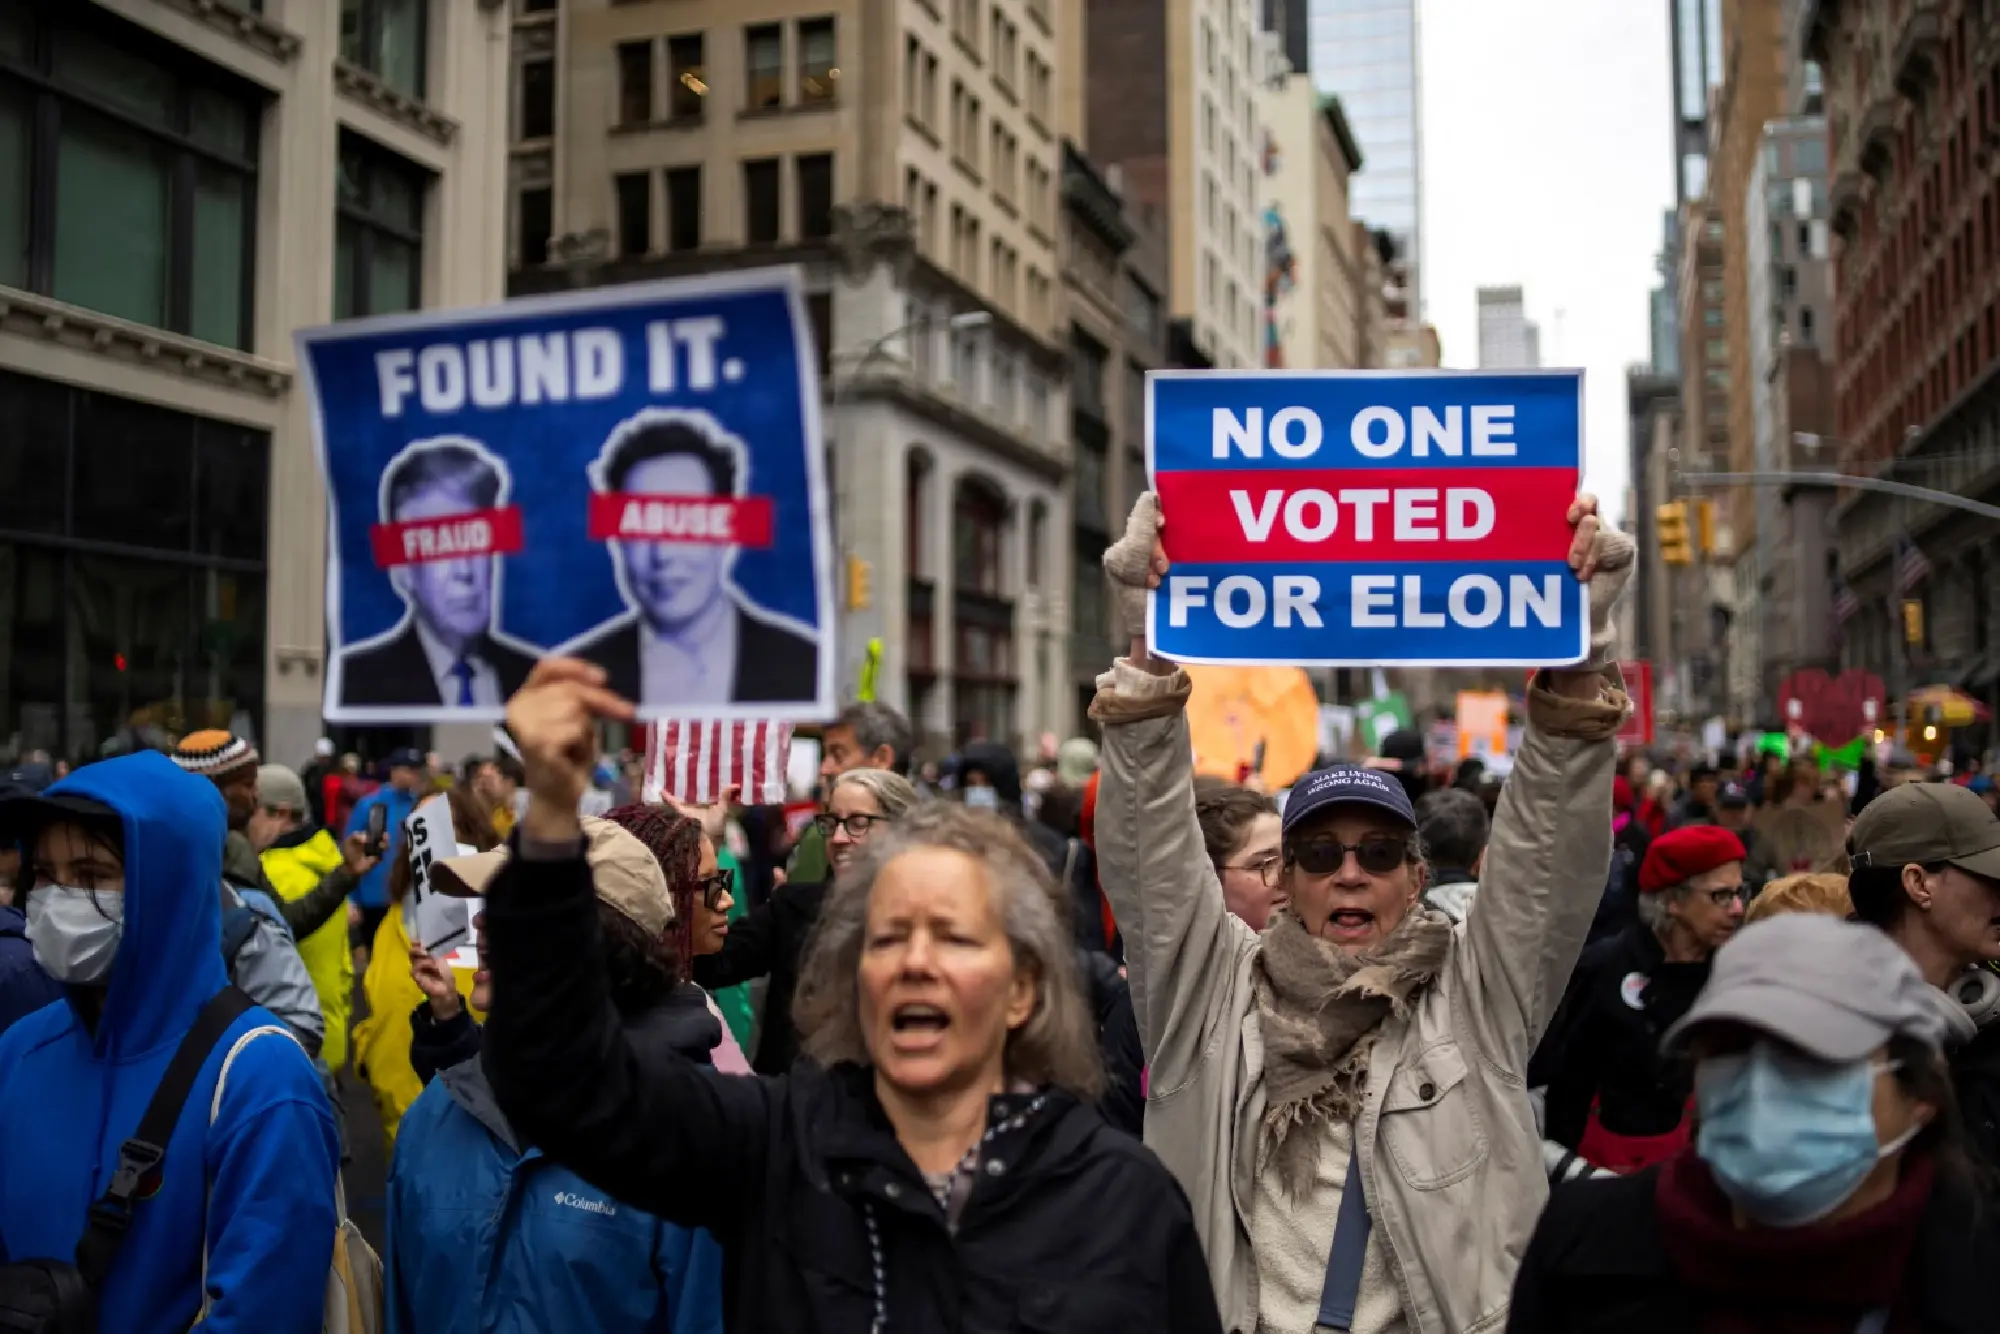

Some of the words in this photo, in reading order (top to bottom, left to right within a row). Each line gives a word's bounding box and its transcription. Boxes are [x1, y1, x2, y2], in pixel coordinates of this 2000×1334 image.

[376, 328, 623, 417] FOUND
[647, 316, 746, 393] IT.
[1212, 405, 1323, 459] NO
[1350, 404, 1518, 458] ONE
[619, 500, 735, 538] ABUSE
[1229, 488, 1496, 543] VOTED
[402, 519, 491, 559] FRAUD
[1169, 575, 1325, 628] FOR
[1350, 575, 1562, 628] ELON
[1307, 778, 1351, 796] WRONG
[1354, 778, 1390, 793] AGAIN
[1312, 770, 1346, 784] MAKE
[564, 1193, 615, 1215] Columbia
